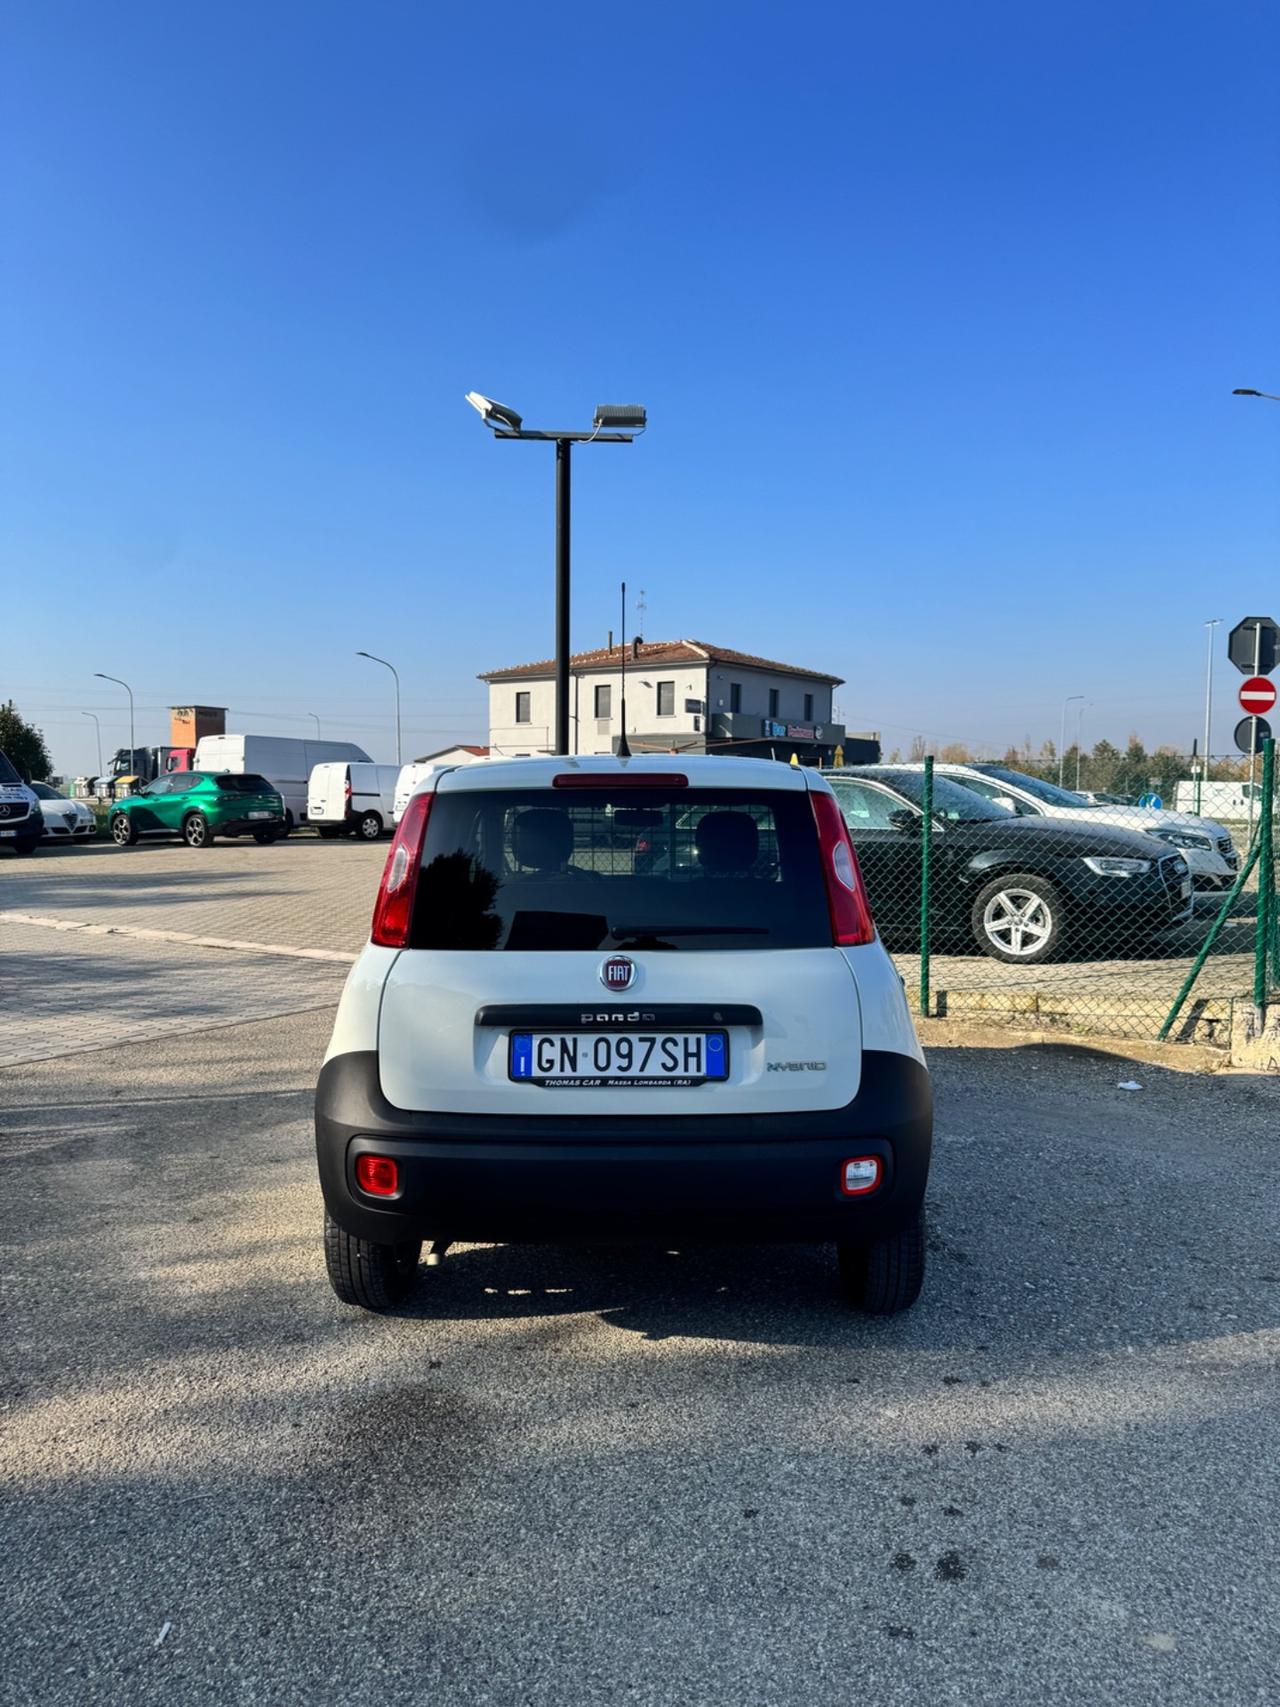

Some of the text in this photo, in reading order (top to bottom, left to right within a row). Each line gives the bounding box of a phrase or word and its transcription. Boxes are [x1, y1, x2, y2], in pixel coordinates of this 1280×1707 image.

[608, 965, 630, 981] FIAT
[581, 1011, 656, 1024] panda
[537, 1037, 701, 1073] GN 097SH
[767, 1061, 827, 1073] HYBRID
[673, 1079, 692, 1087] (RA)
